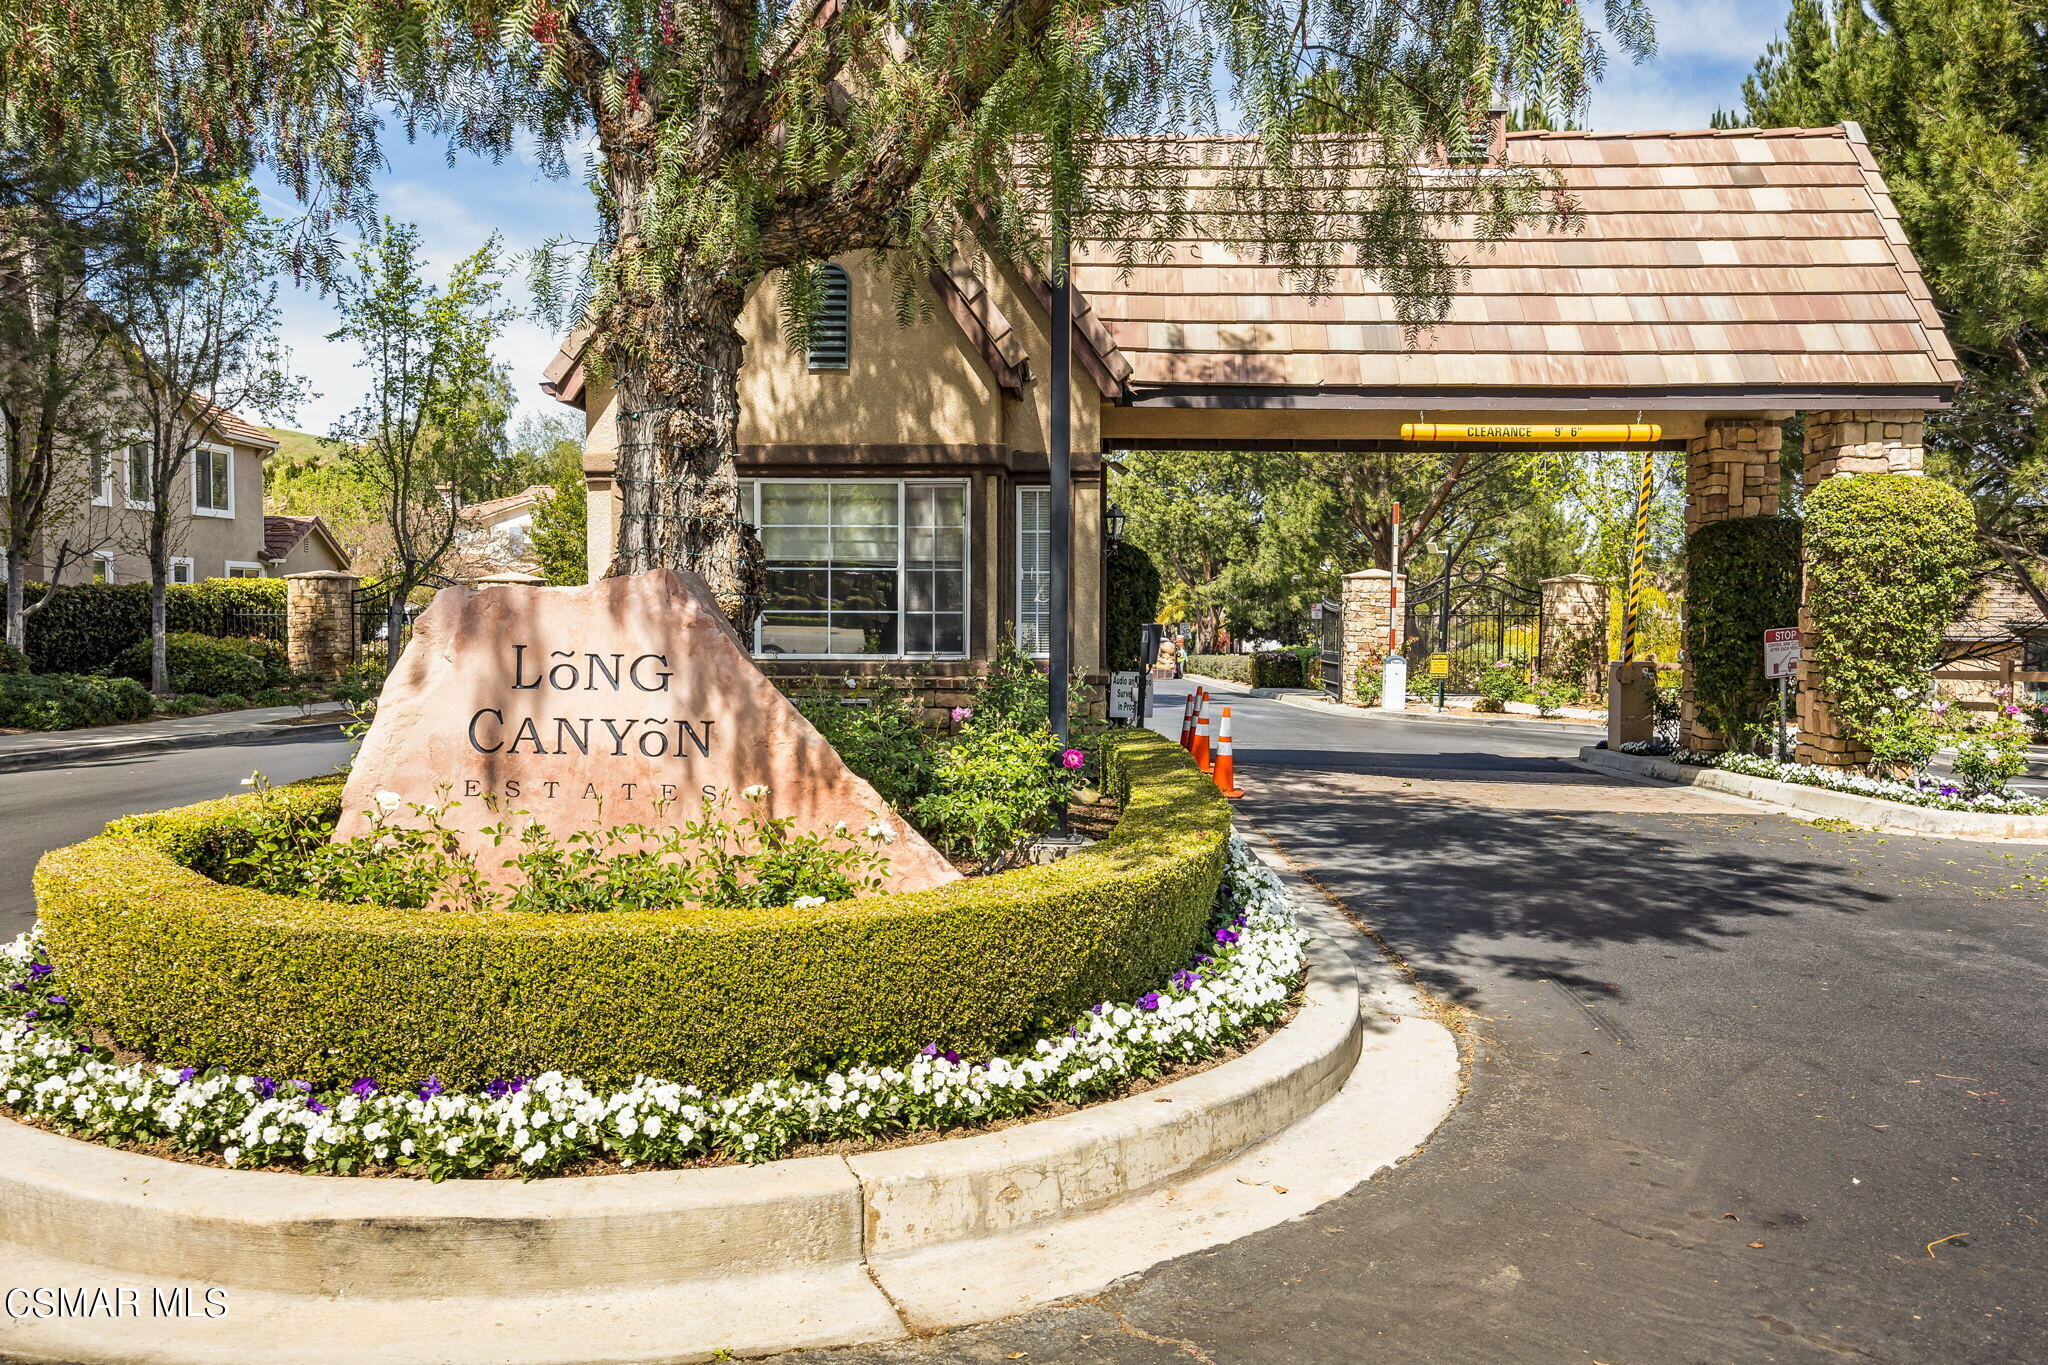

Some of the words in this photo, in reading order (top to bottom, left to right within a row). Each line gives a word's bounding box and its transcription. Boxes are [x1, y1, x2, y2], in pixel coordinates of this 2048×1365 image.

[1467, 426, 1532, 437] CLEARANCE
[1775, 631, 1797, 641] STOP
[1113, 675, 1127, 686] Audio
[463, 779, 717, 802] ESTATES
